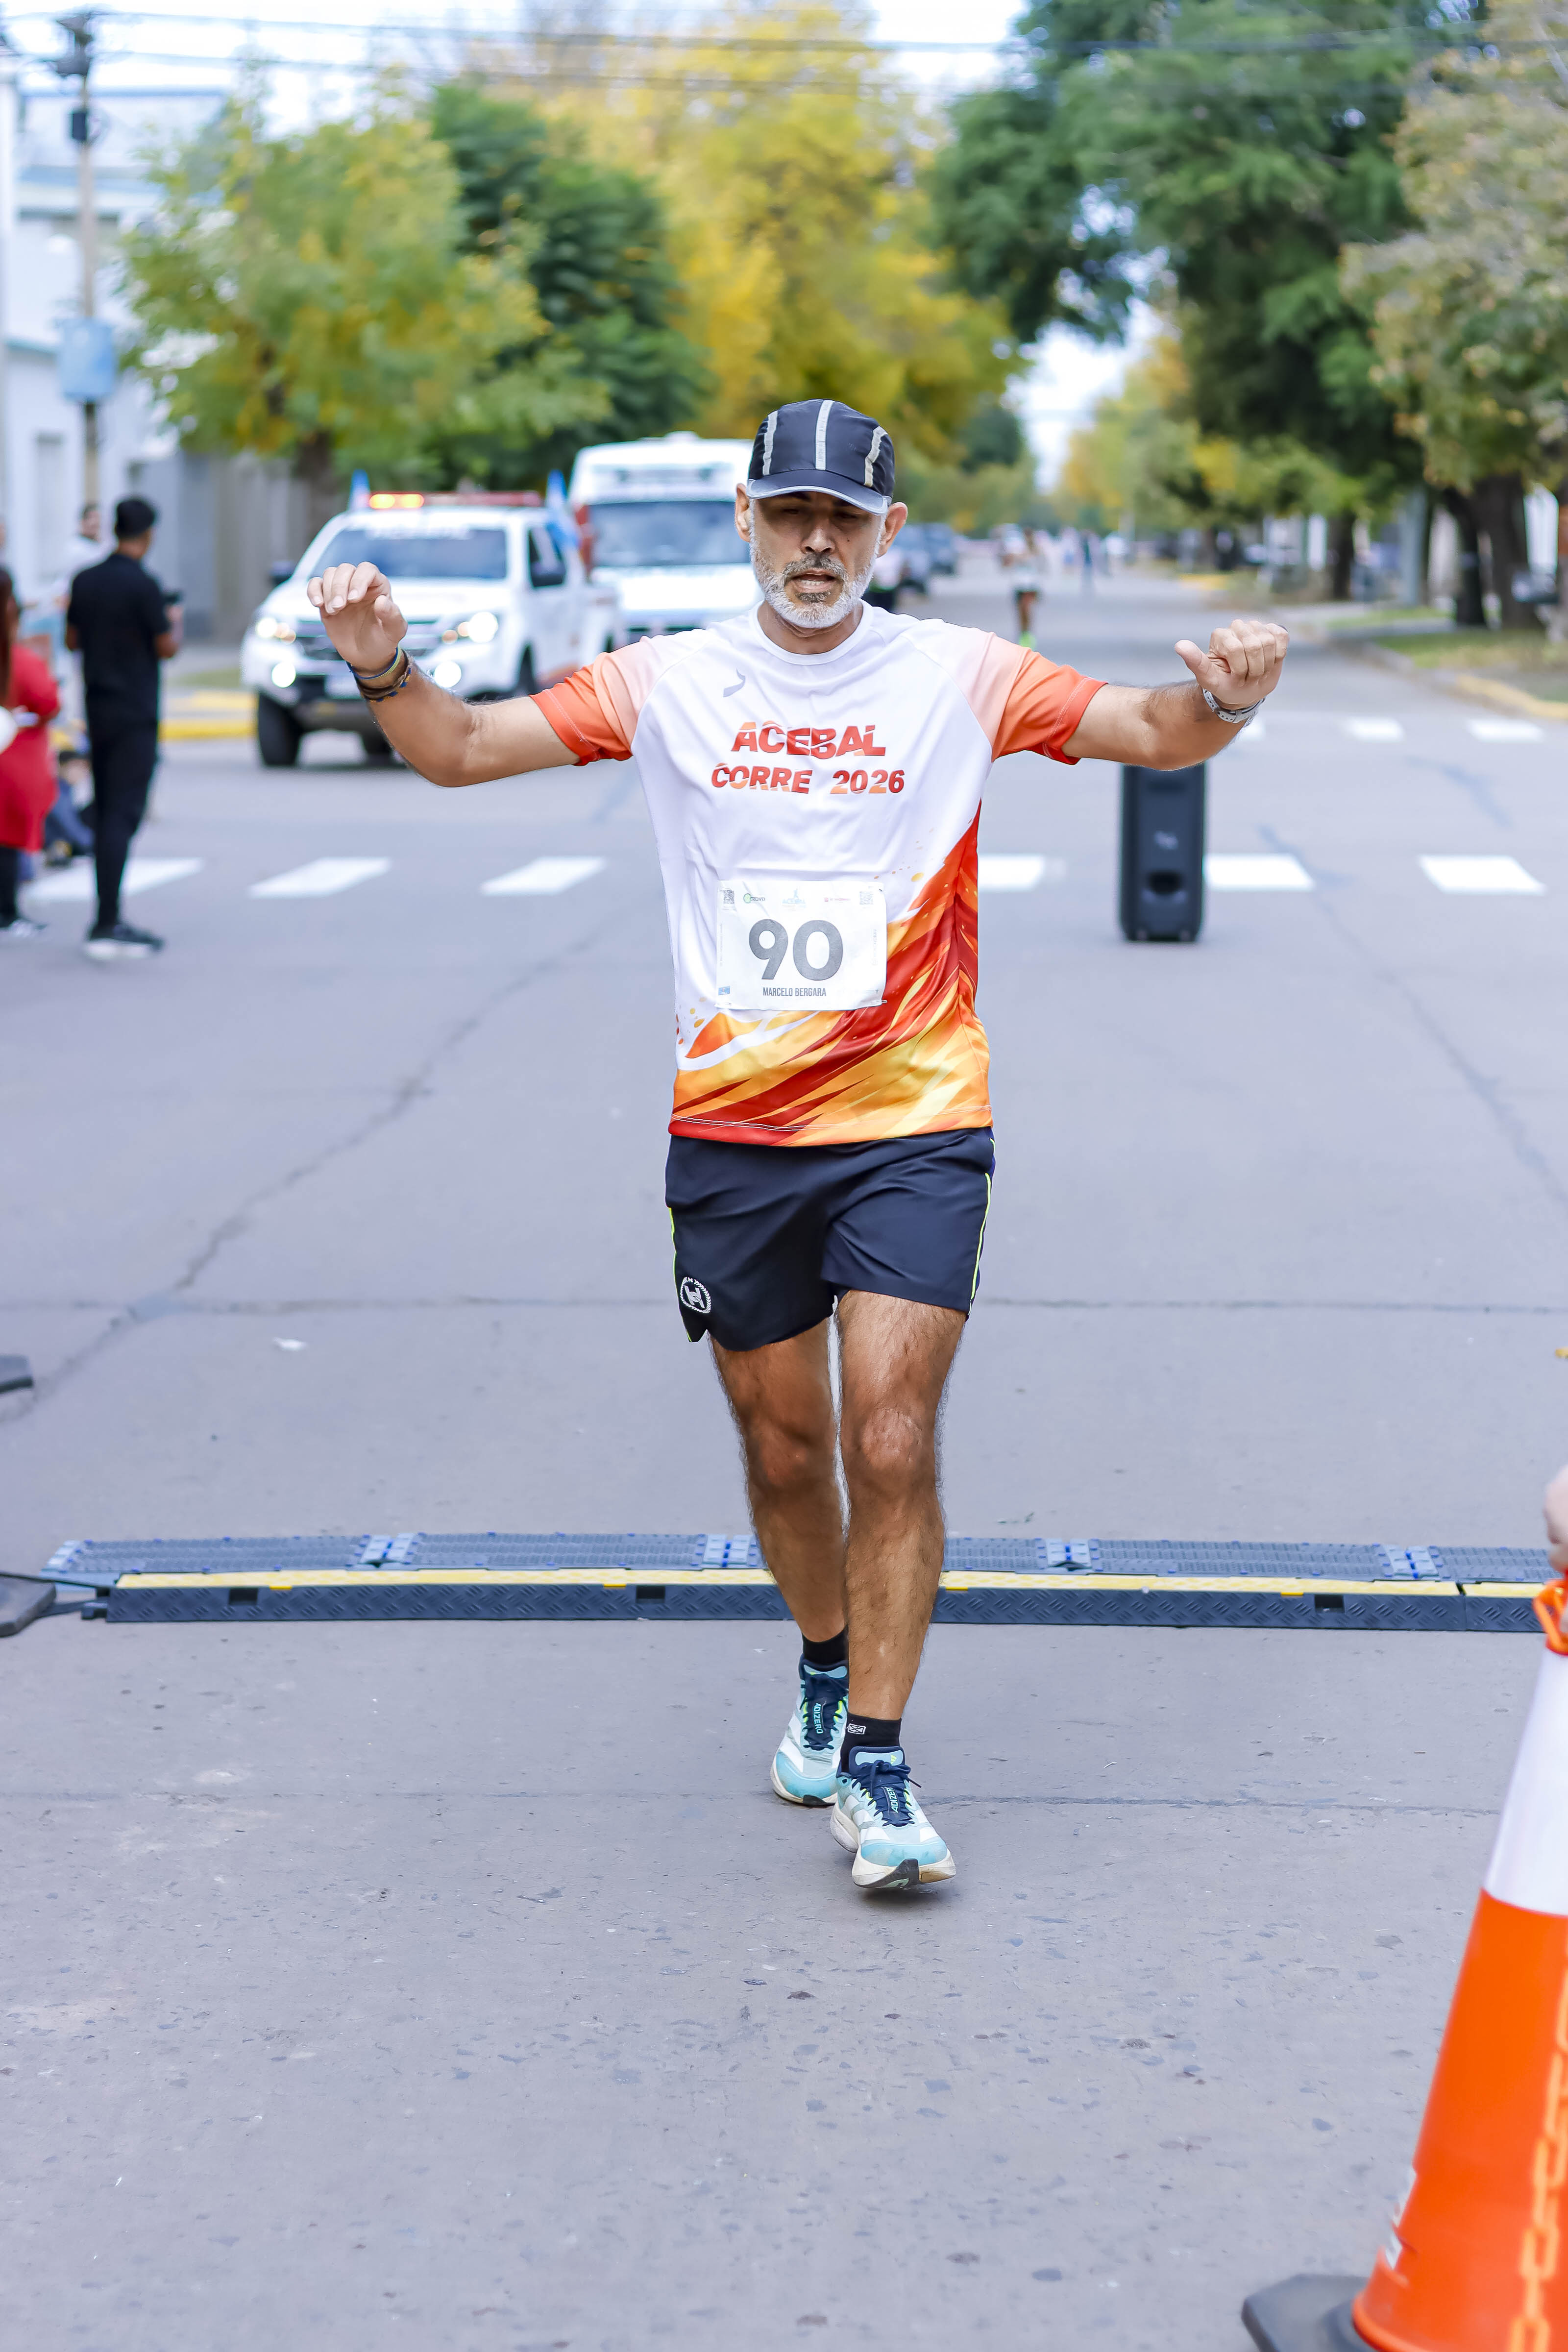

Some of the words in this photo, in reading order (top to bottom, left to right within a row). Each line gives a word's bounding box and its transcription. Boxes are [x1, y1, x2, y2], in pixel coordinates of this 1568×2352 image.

[731, 720, 886, 759] ACEBAL
[711, 762, 812, 794] CORRE
[830, 769, 905, 794] 2026
[749, 919, 843, 981] 90
[763, 987, 793, 996] MARCELO
[795, 987, 826, 996] BERGARA
[814, 1703, 824, 1734] ADIZERO
[884, 1787, 899, 1813] ADIZER
